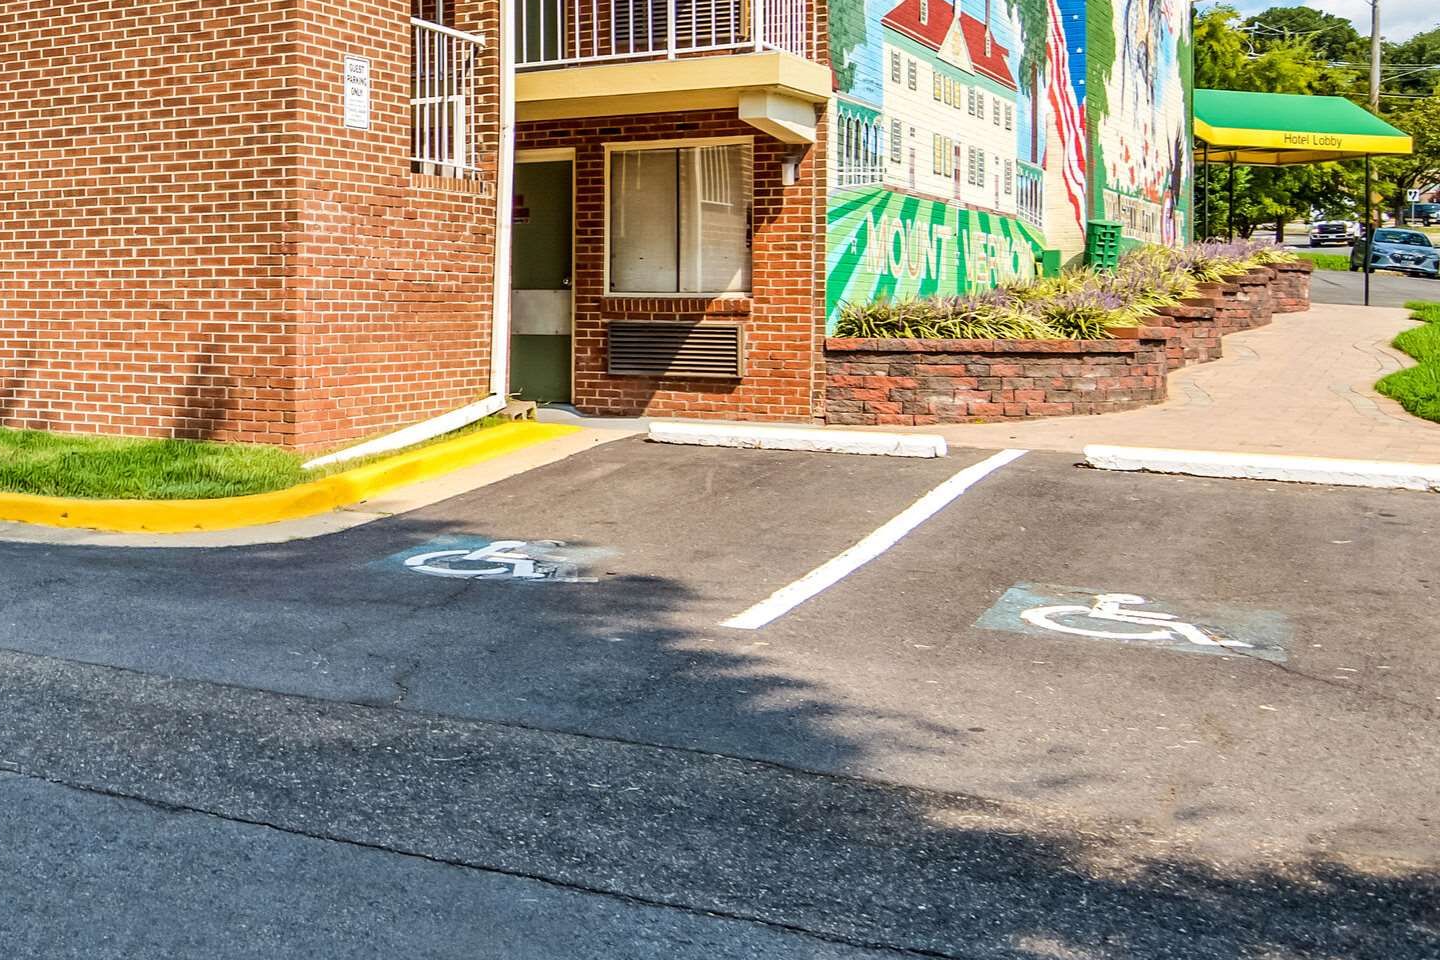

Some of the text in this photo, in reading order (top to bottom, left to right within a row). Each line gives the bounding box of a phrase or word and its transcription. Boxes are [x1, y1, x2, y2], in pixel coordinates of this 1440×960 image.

[1284, 133, 1343, 149] Hotel Lobby
[866, 211, 1034, 286] MOUNT VERNON
